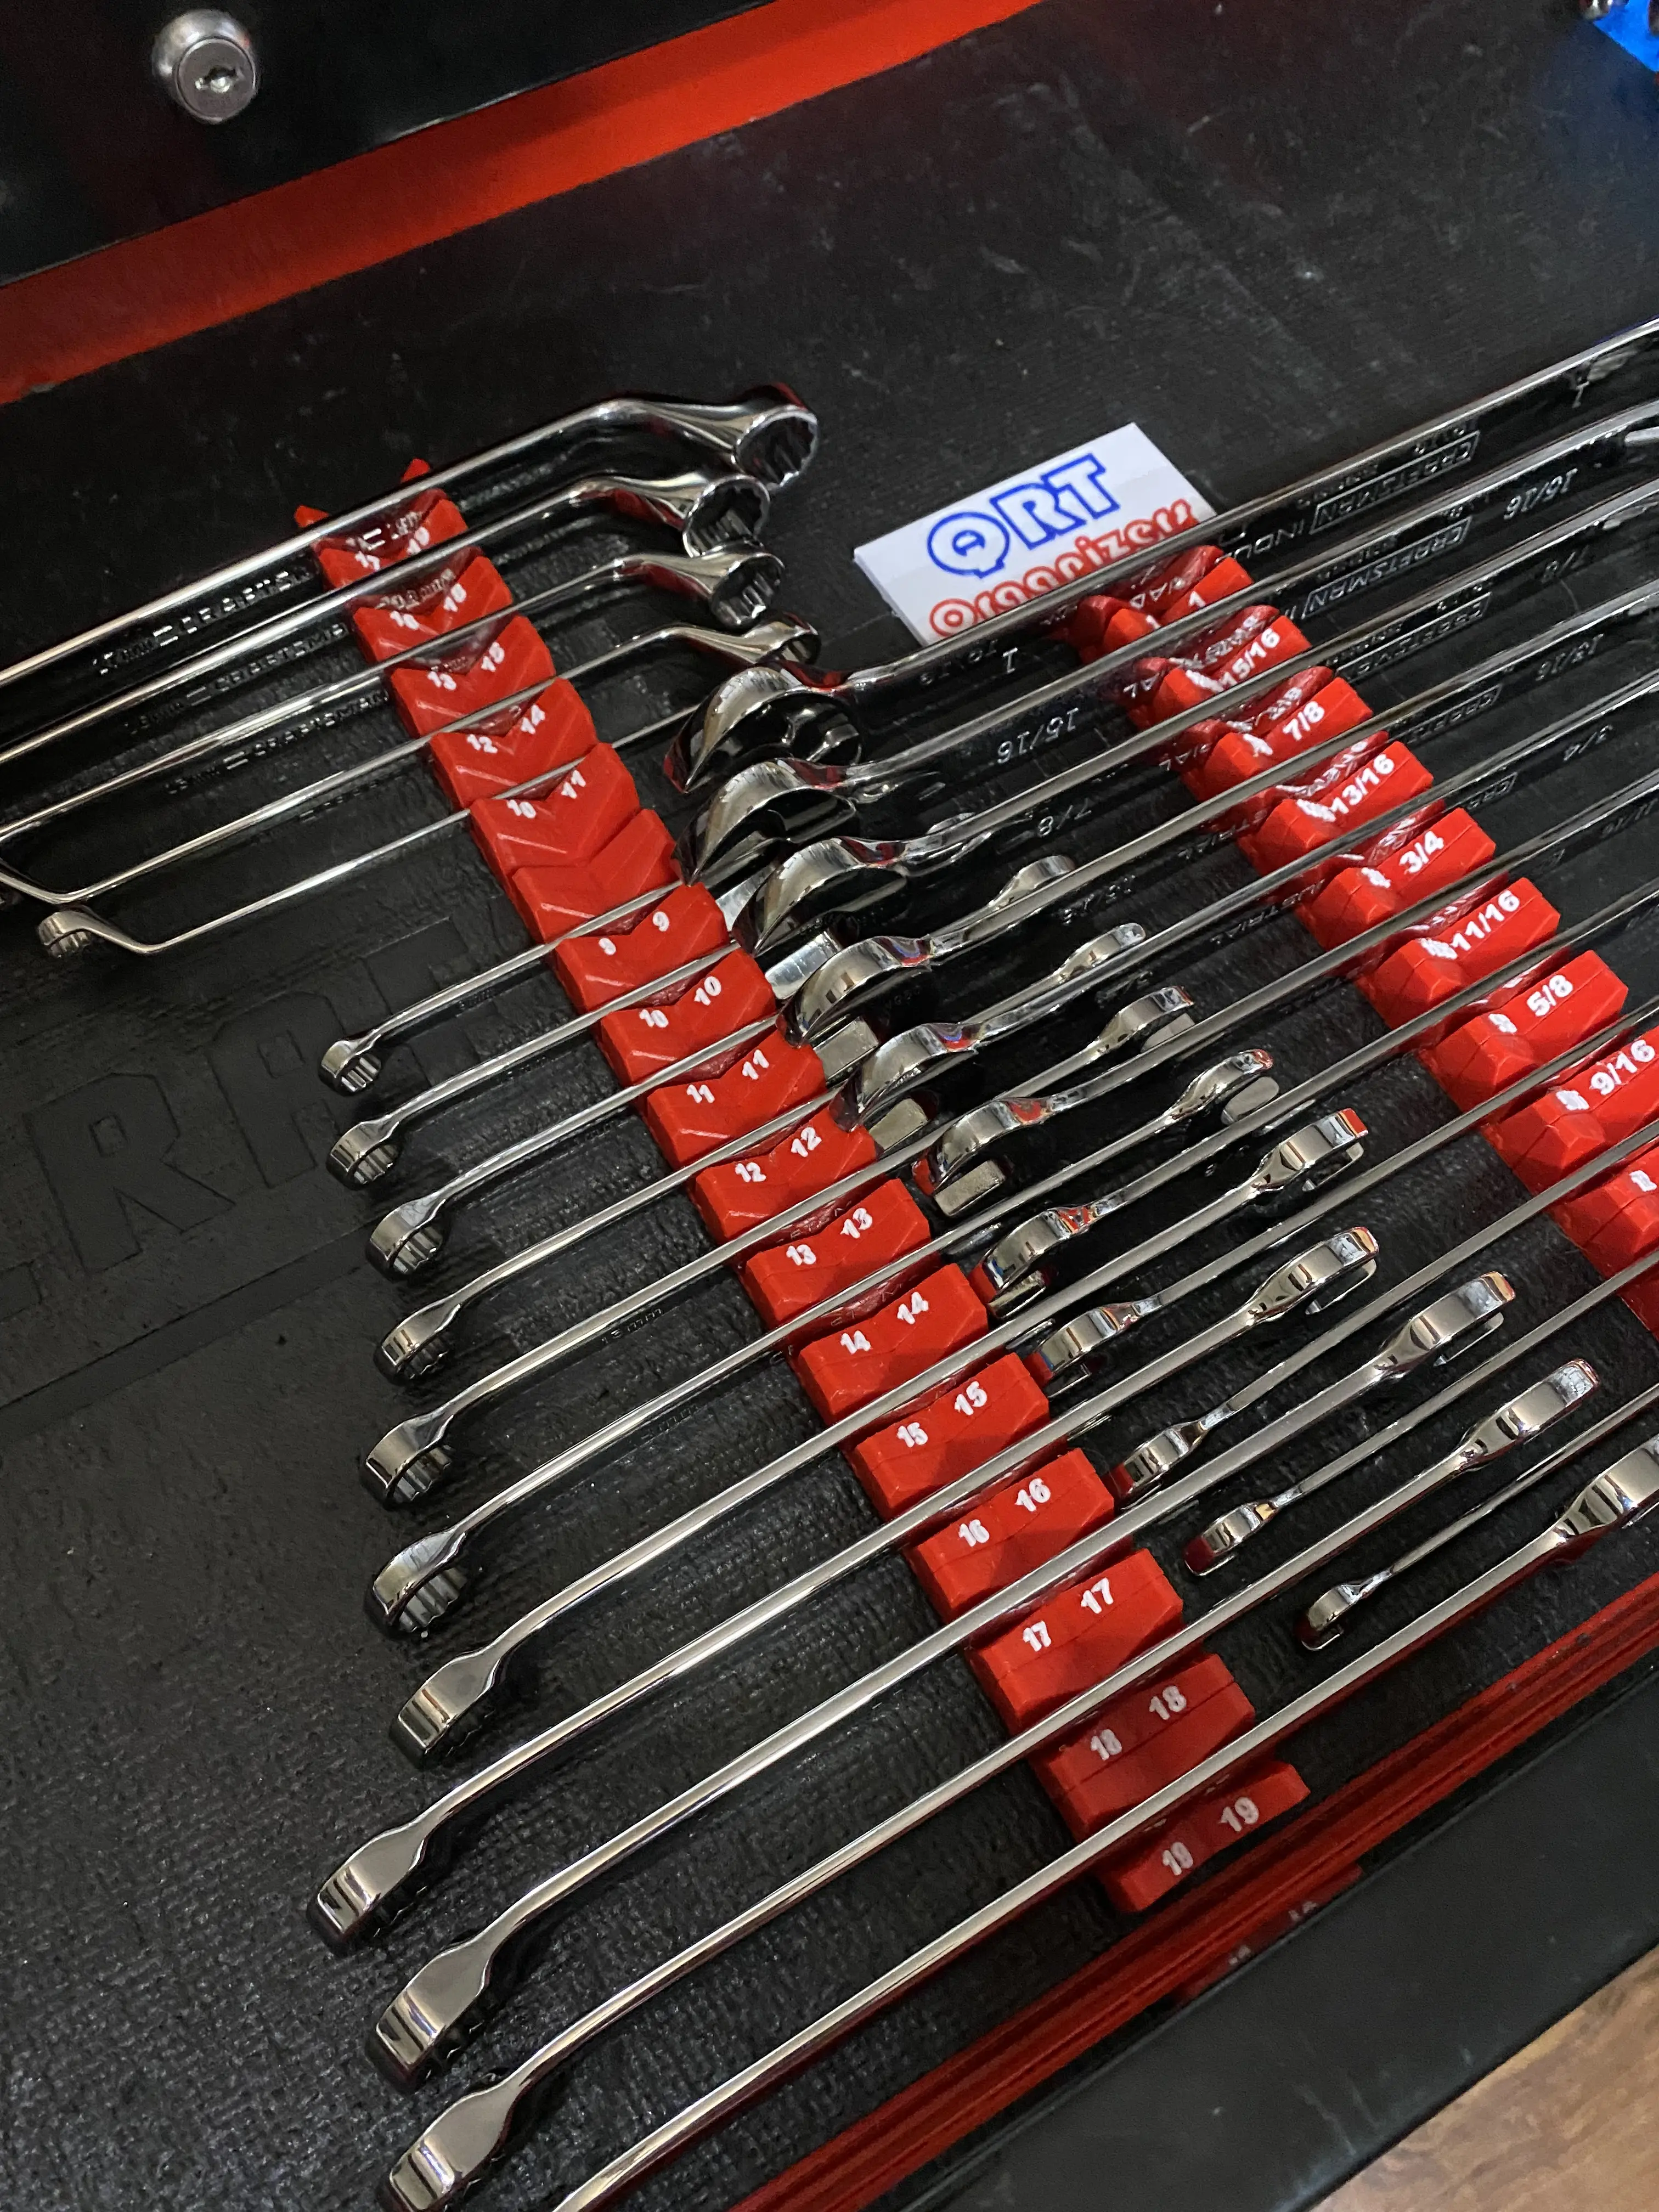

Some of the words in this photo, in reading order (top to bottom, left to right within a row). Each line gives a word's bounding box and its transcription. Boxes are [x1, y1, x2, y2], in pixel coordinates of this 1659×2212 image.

[1504, 467, 1578, 520] 15/16
[927, 453, 1120, 578] QRT
[1311, 525, 1464, 608] CRAFTSMAN
[1219, 627, 1280, 685] 15/16
[996, 708, 1079, 764] 15/16
[1283, 701, 1325, 741] 7/8
[466, 733, 498, 754] 12
[561, 769, 586, 799] 11
[1330, 754, 1394, 815] 13/16
[506, 799, 537, 819] 10
[1399, 831, 1444, 874] 3/4
[652, 911, 669, 932] 9
[1452, 889, 1520, 951] 11/16
[694, 976, 721, 1006] 10
[1527, 974, 1573, 1017] 5/8
[639, 1009, 669, 1028] 10
[742, 1049, 769, 1080] 11
[1589, 1035, 1656, 1096] 9/16
[686, 1084, 715, 1103] 11
[791, 1126, 822, 1157] 12
[735, 1162, 766, 1183] 12
[840, 1207, 873, 1239] 13
[786, 1244, 816, 1266] 13
[897, 1291, 929, 1324] 14
[840, 1330, 871, 1354] 14
[954, 1381, 988, 1416] 15
[896, 1422, 928, 1448] 15
[1015, 1478, 1051, 1512] 16
[958, 1519, 990, 1547] 16
[1080, 1577, 1114, 1614] 17
[1022, 1621, 1052, 1652] 17
[1149, 1685, 1187, 1720] 18
[1090, 1729, 1122, 1761] 18
[1219, 1797, 1259, 1832] 19
[1162, 1842, 1193, 1876] 19
